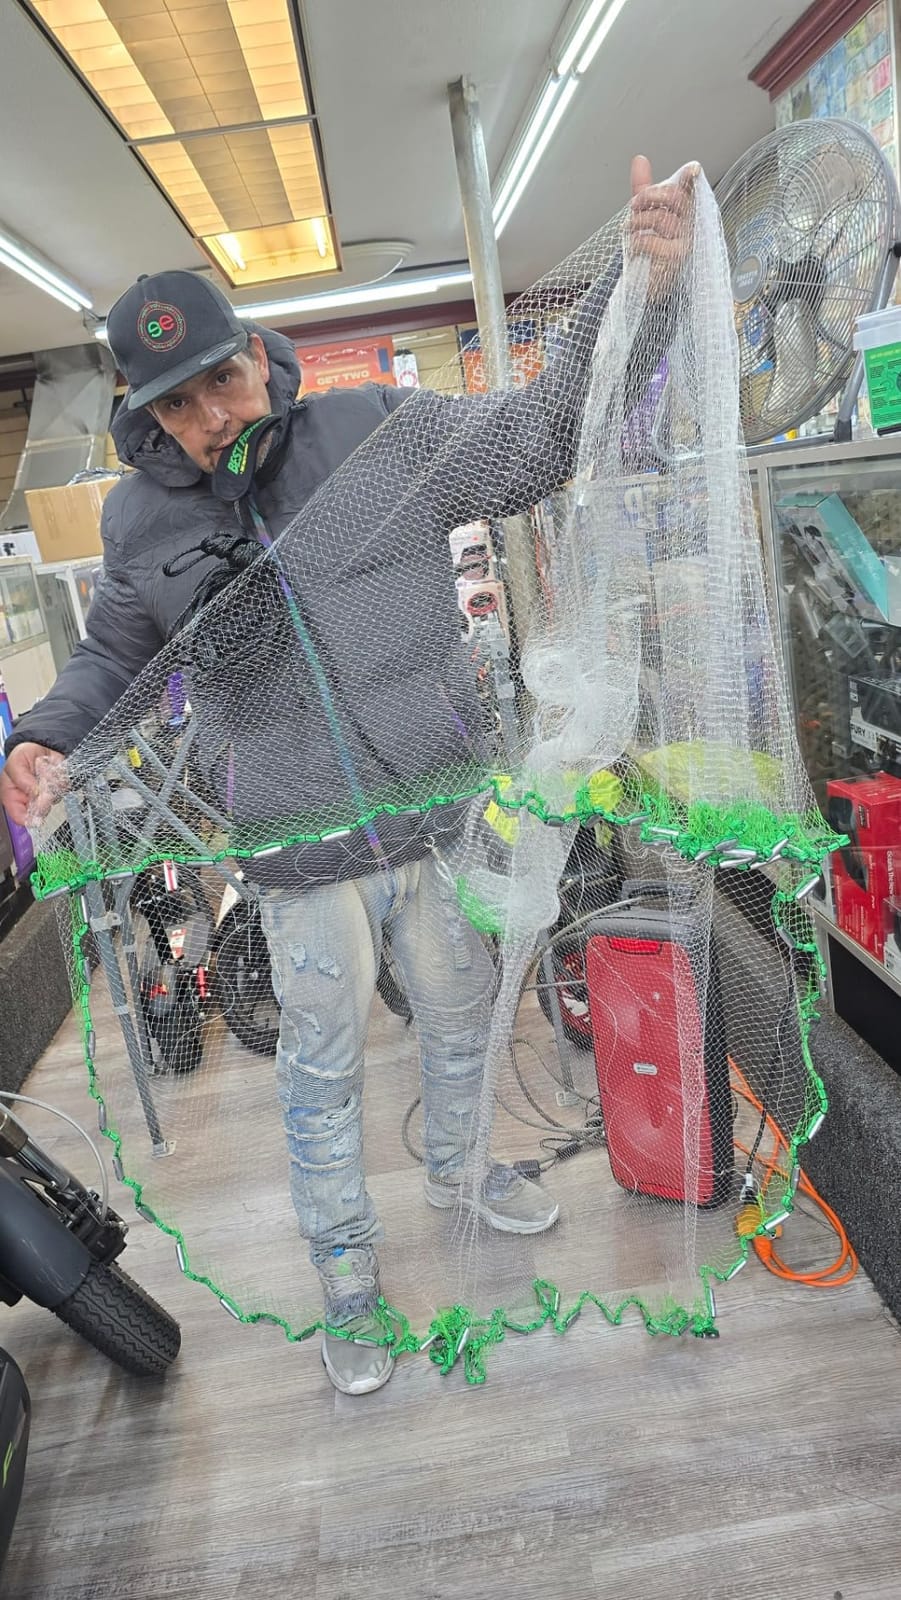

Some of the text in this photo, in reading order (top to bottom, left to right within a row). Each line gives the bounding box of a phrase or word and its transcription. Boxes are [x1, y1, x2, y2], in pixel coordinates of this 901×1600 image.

[316, 375, 339, 386] GET
[342, 369, 370, 381] TWO
[227, 443, 244, 475] BEST
